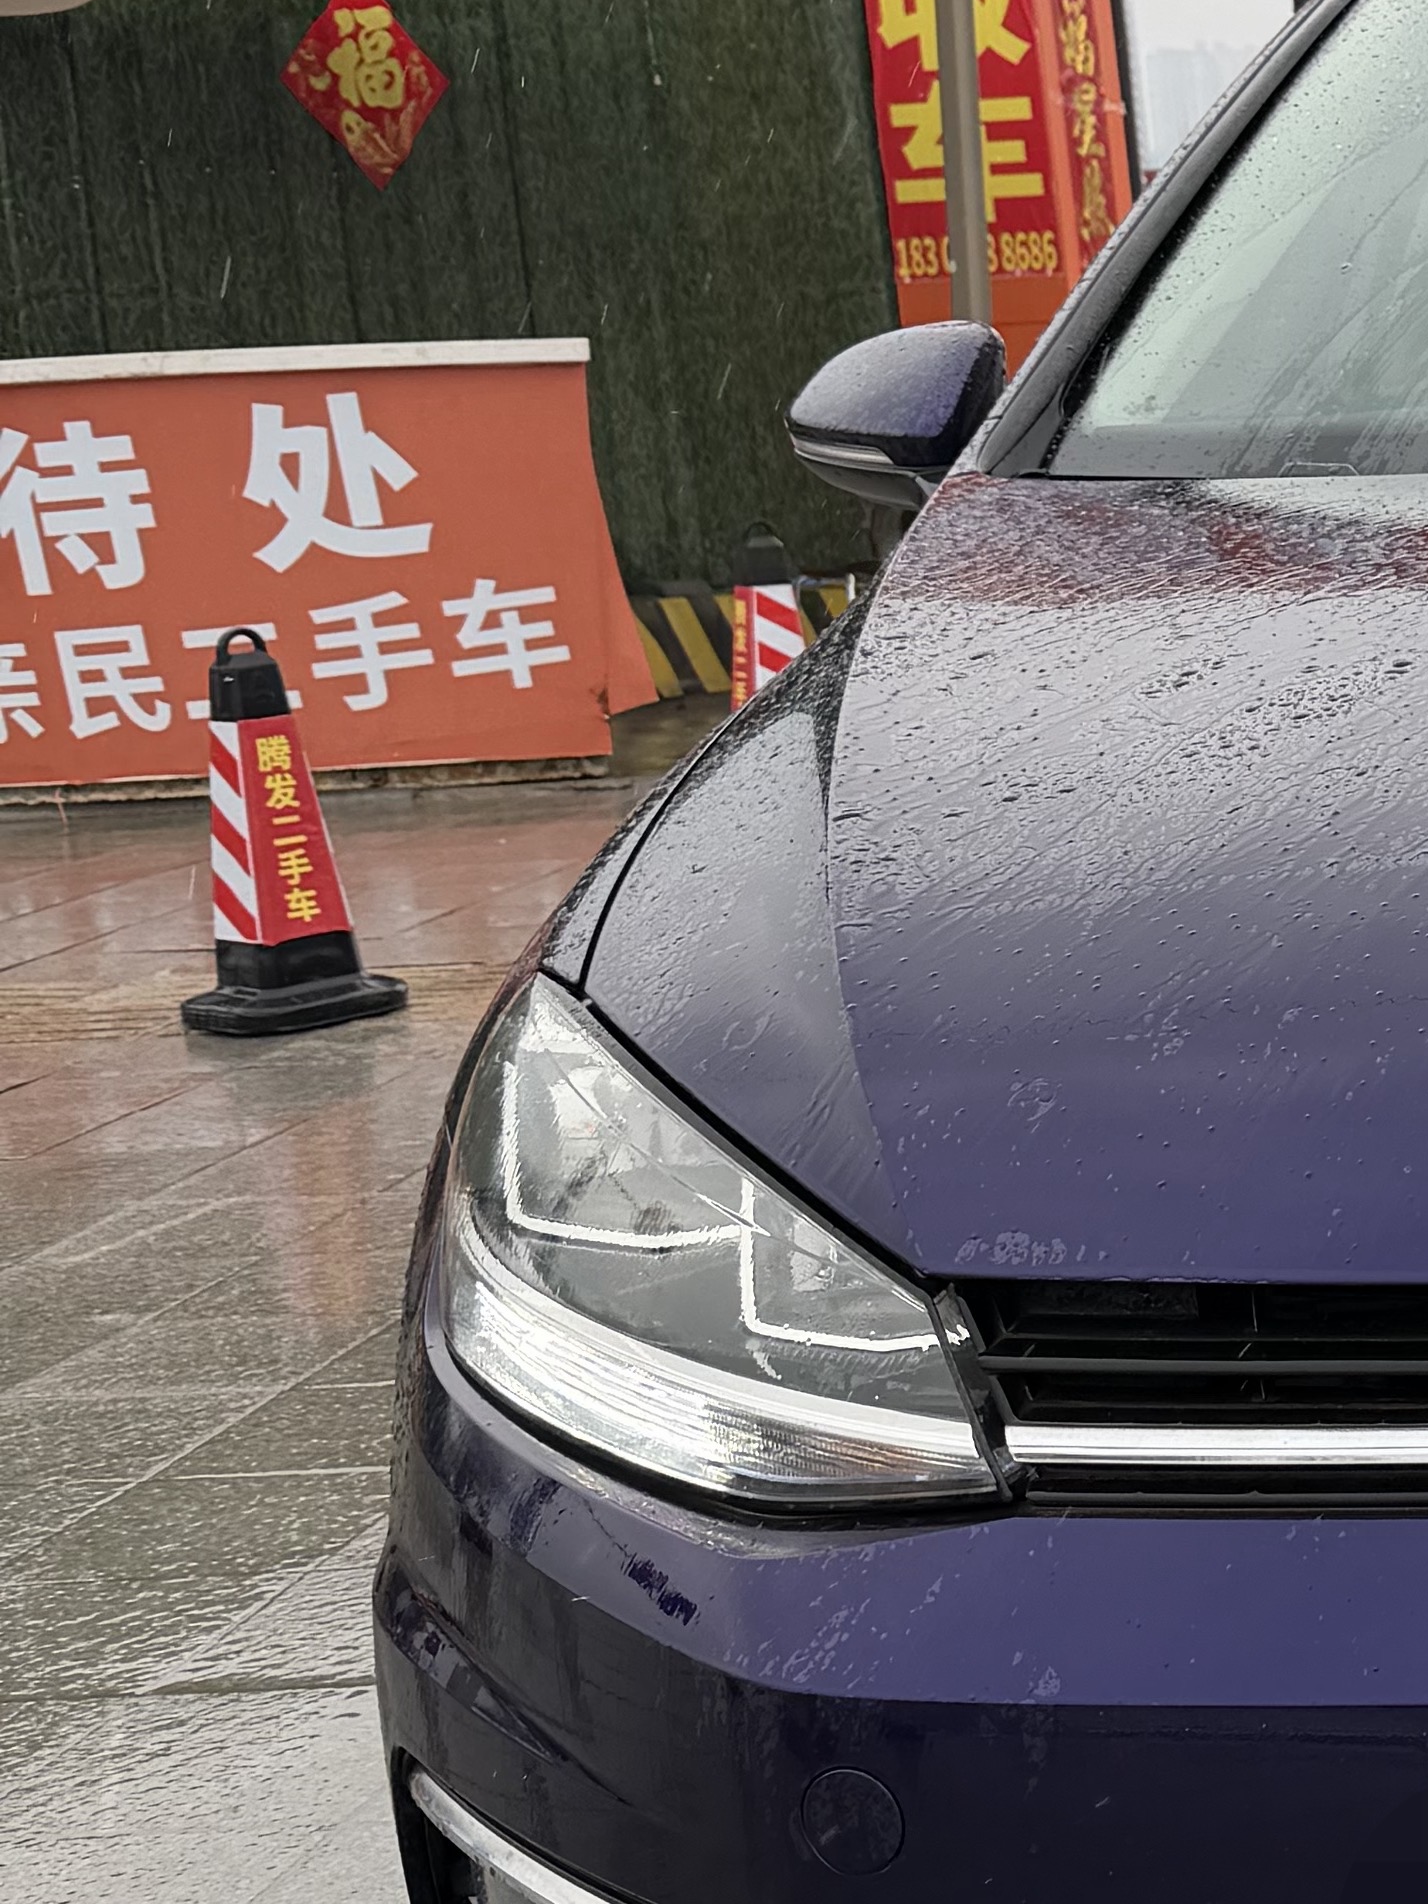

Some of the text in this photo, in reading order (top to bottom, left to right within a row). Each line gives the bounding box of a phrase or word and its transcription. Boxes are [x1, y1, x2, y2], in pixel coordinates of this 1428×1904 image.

[326, 5, 405, 109] 福
[254, 734, 322, 924] 腾发二手车
